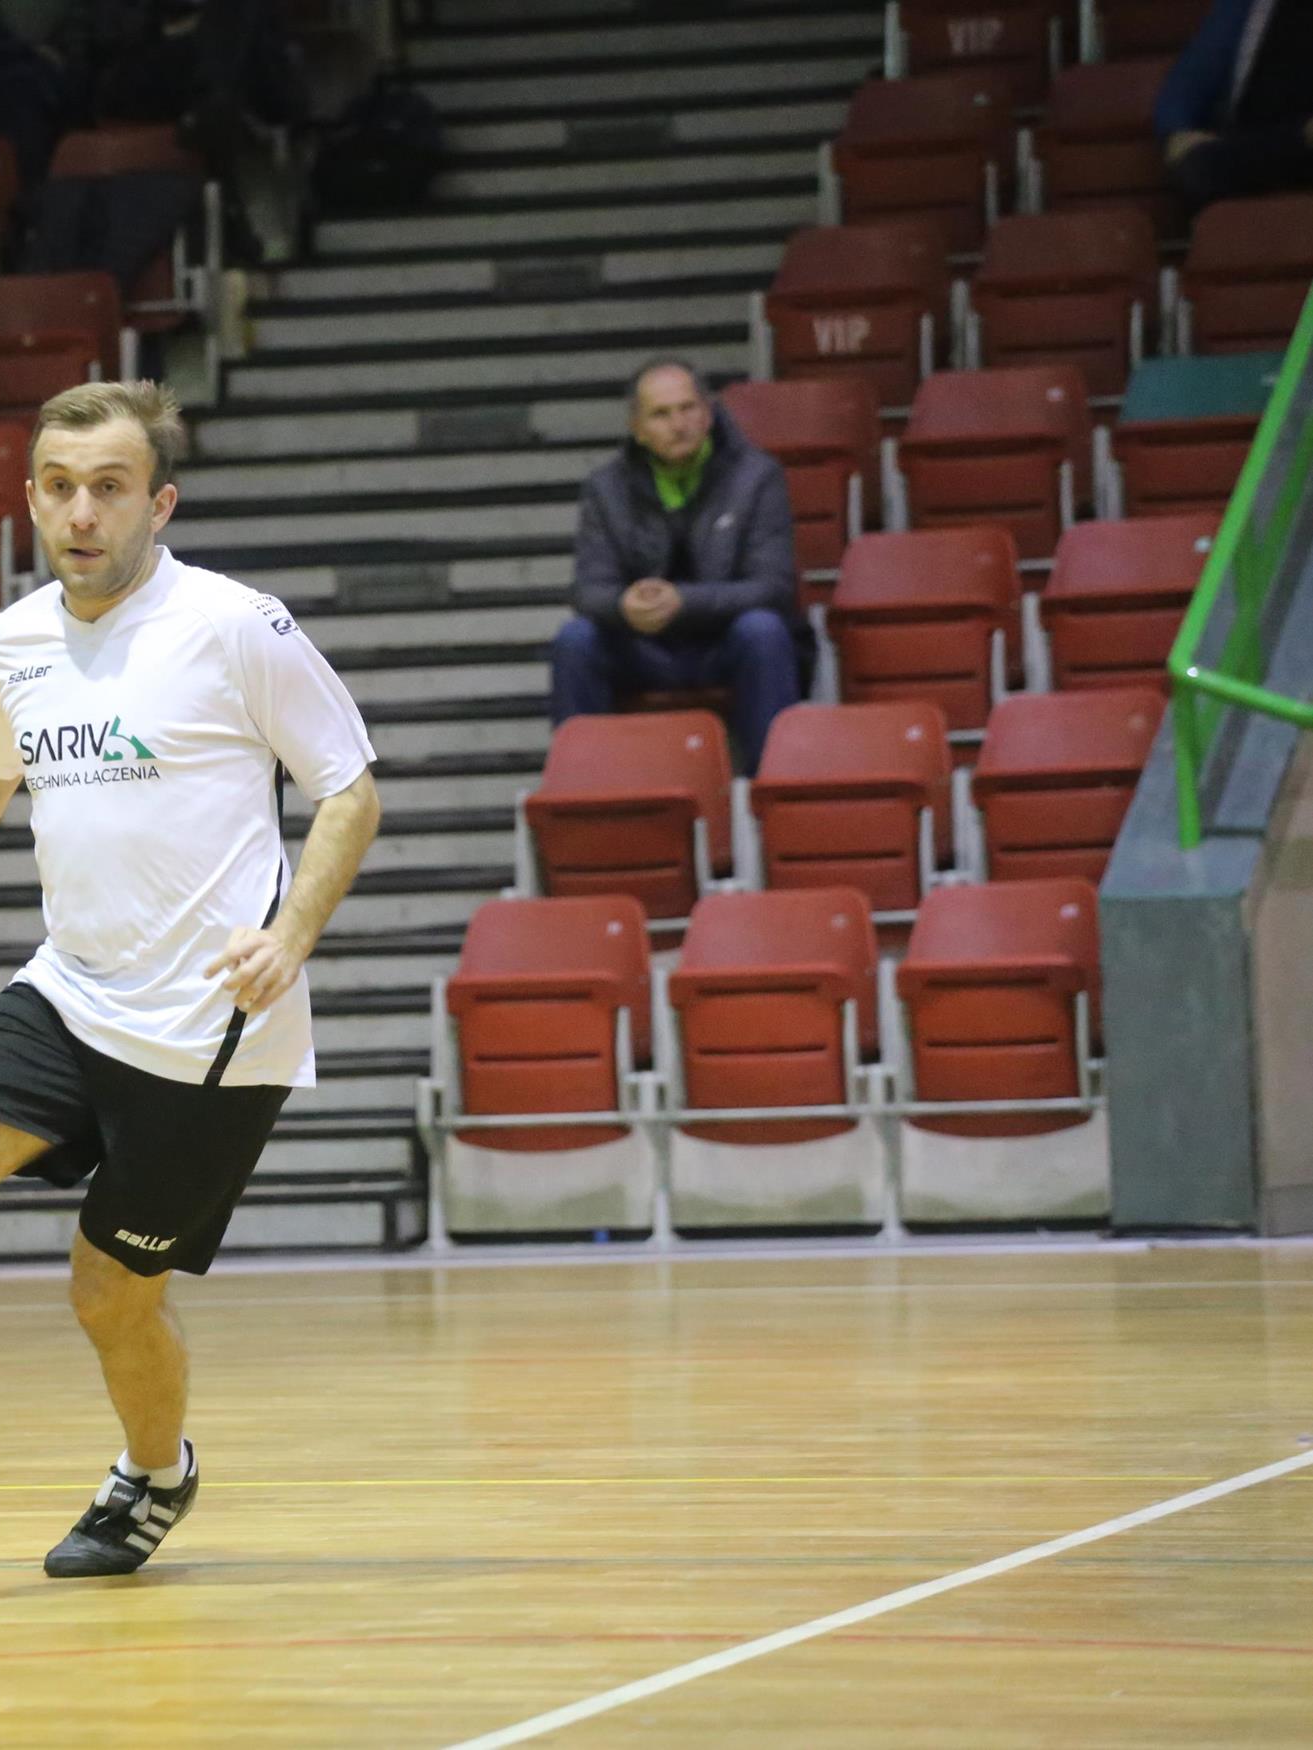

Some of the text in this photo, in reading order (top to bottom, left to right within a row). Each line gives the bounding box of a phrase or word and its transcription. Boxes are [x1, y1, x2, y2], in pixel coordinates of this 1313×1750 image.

[948, 19, 1003, 55] VIP
[813, 315, 870, 354] VIP
[8, 665, 52, 684] saller
[27, 765, 160, 791] TECHNIKA ŁĄCZENIA
